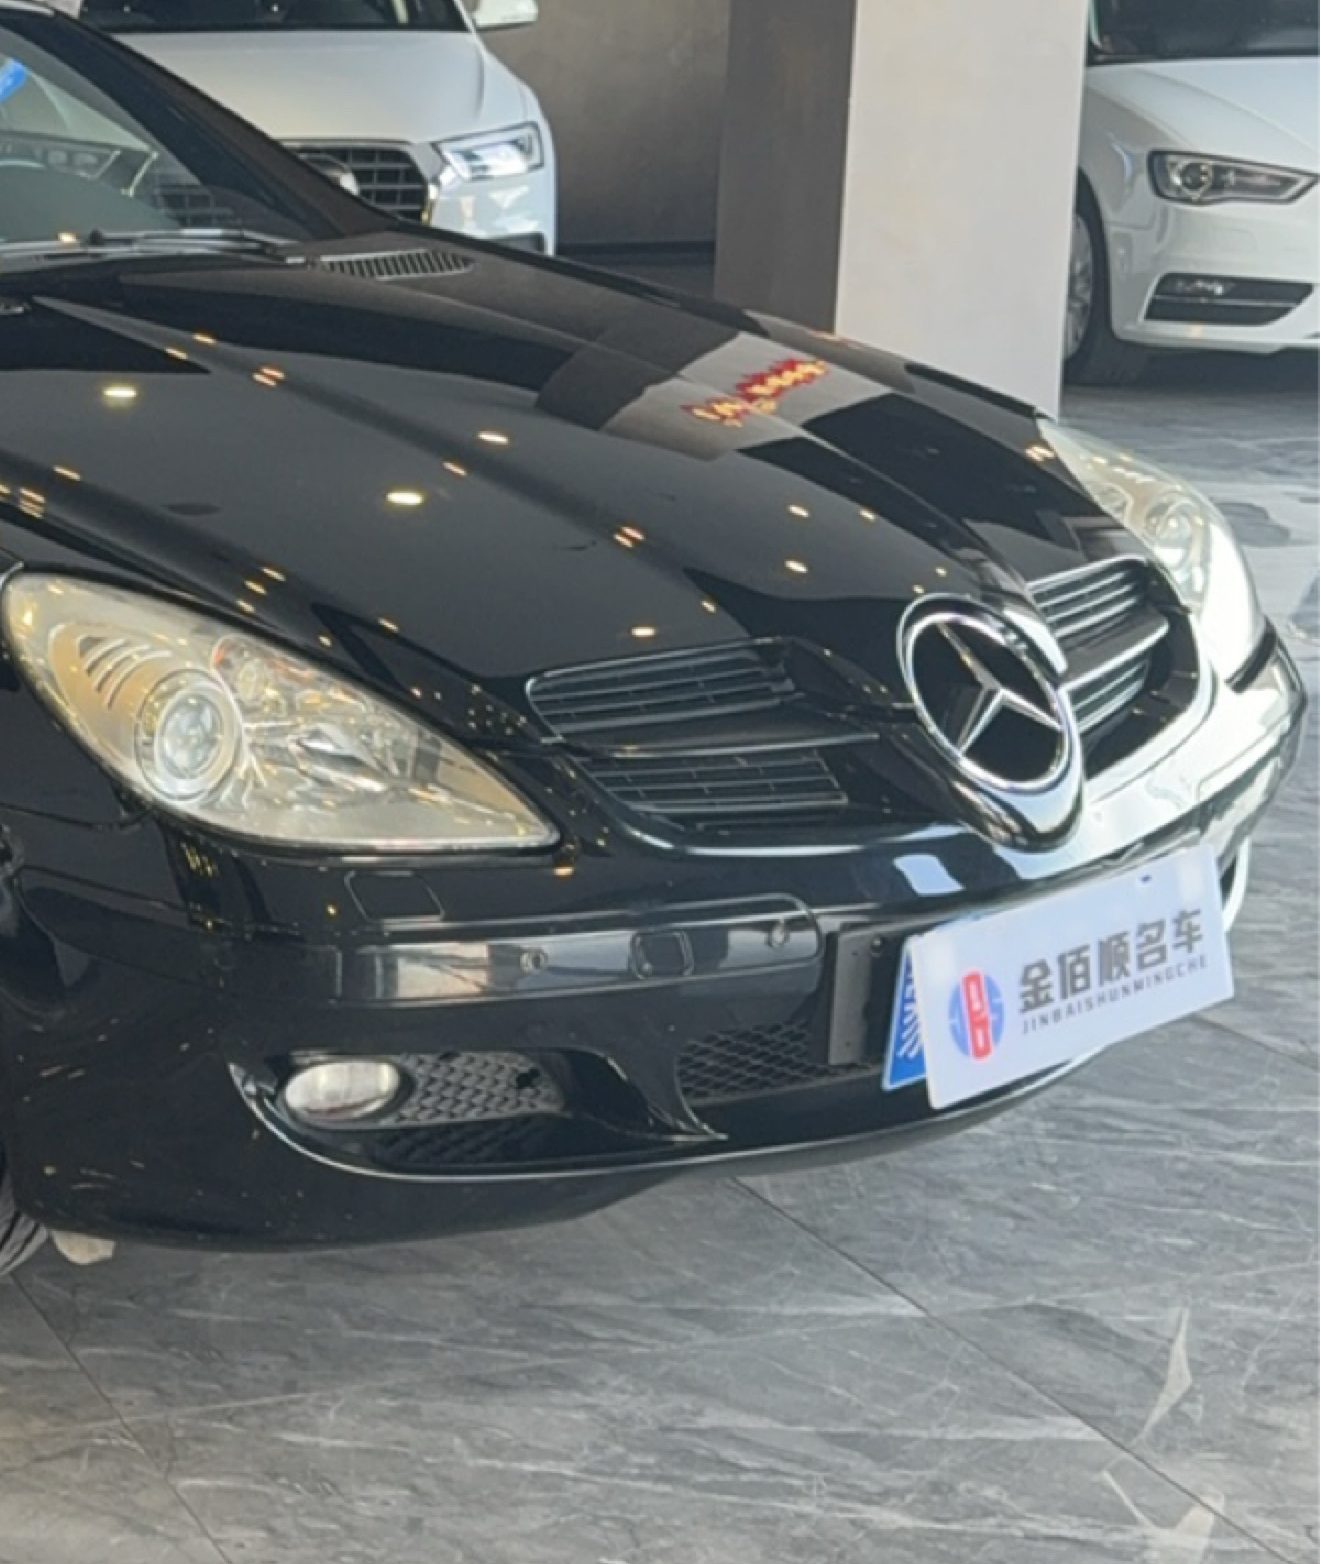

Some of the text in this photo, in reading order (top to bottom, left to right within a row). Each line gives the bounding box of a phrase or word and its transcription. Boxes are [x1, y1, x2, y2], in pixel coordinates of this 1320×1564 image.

[1019, 908, 1204, 1014] 金佰顺名车
[1022, 953, 1208, 1035] JINBAISHUNMINGCHE
